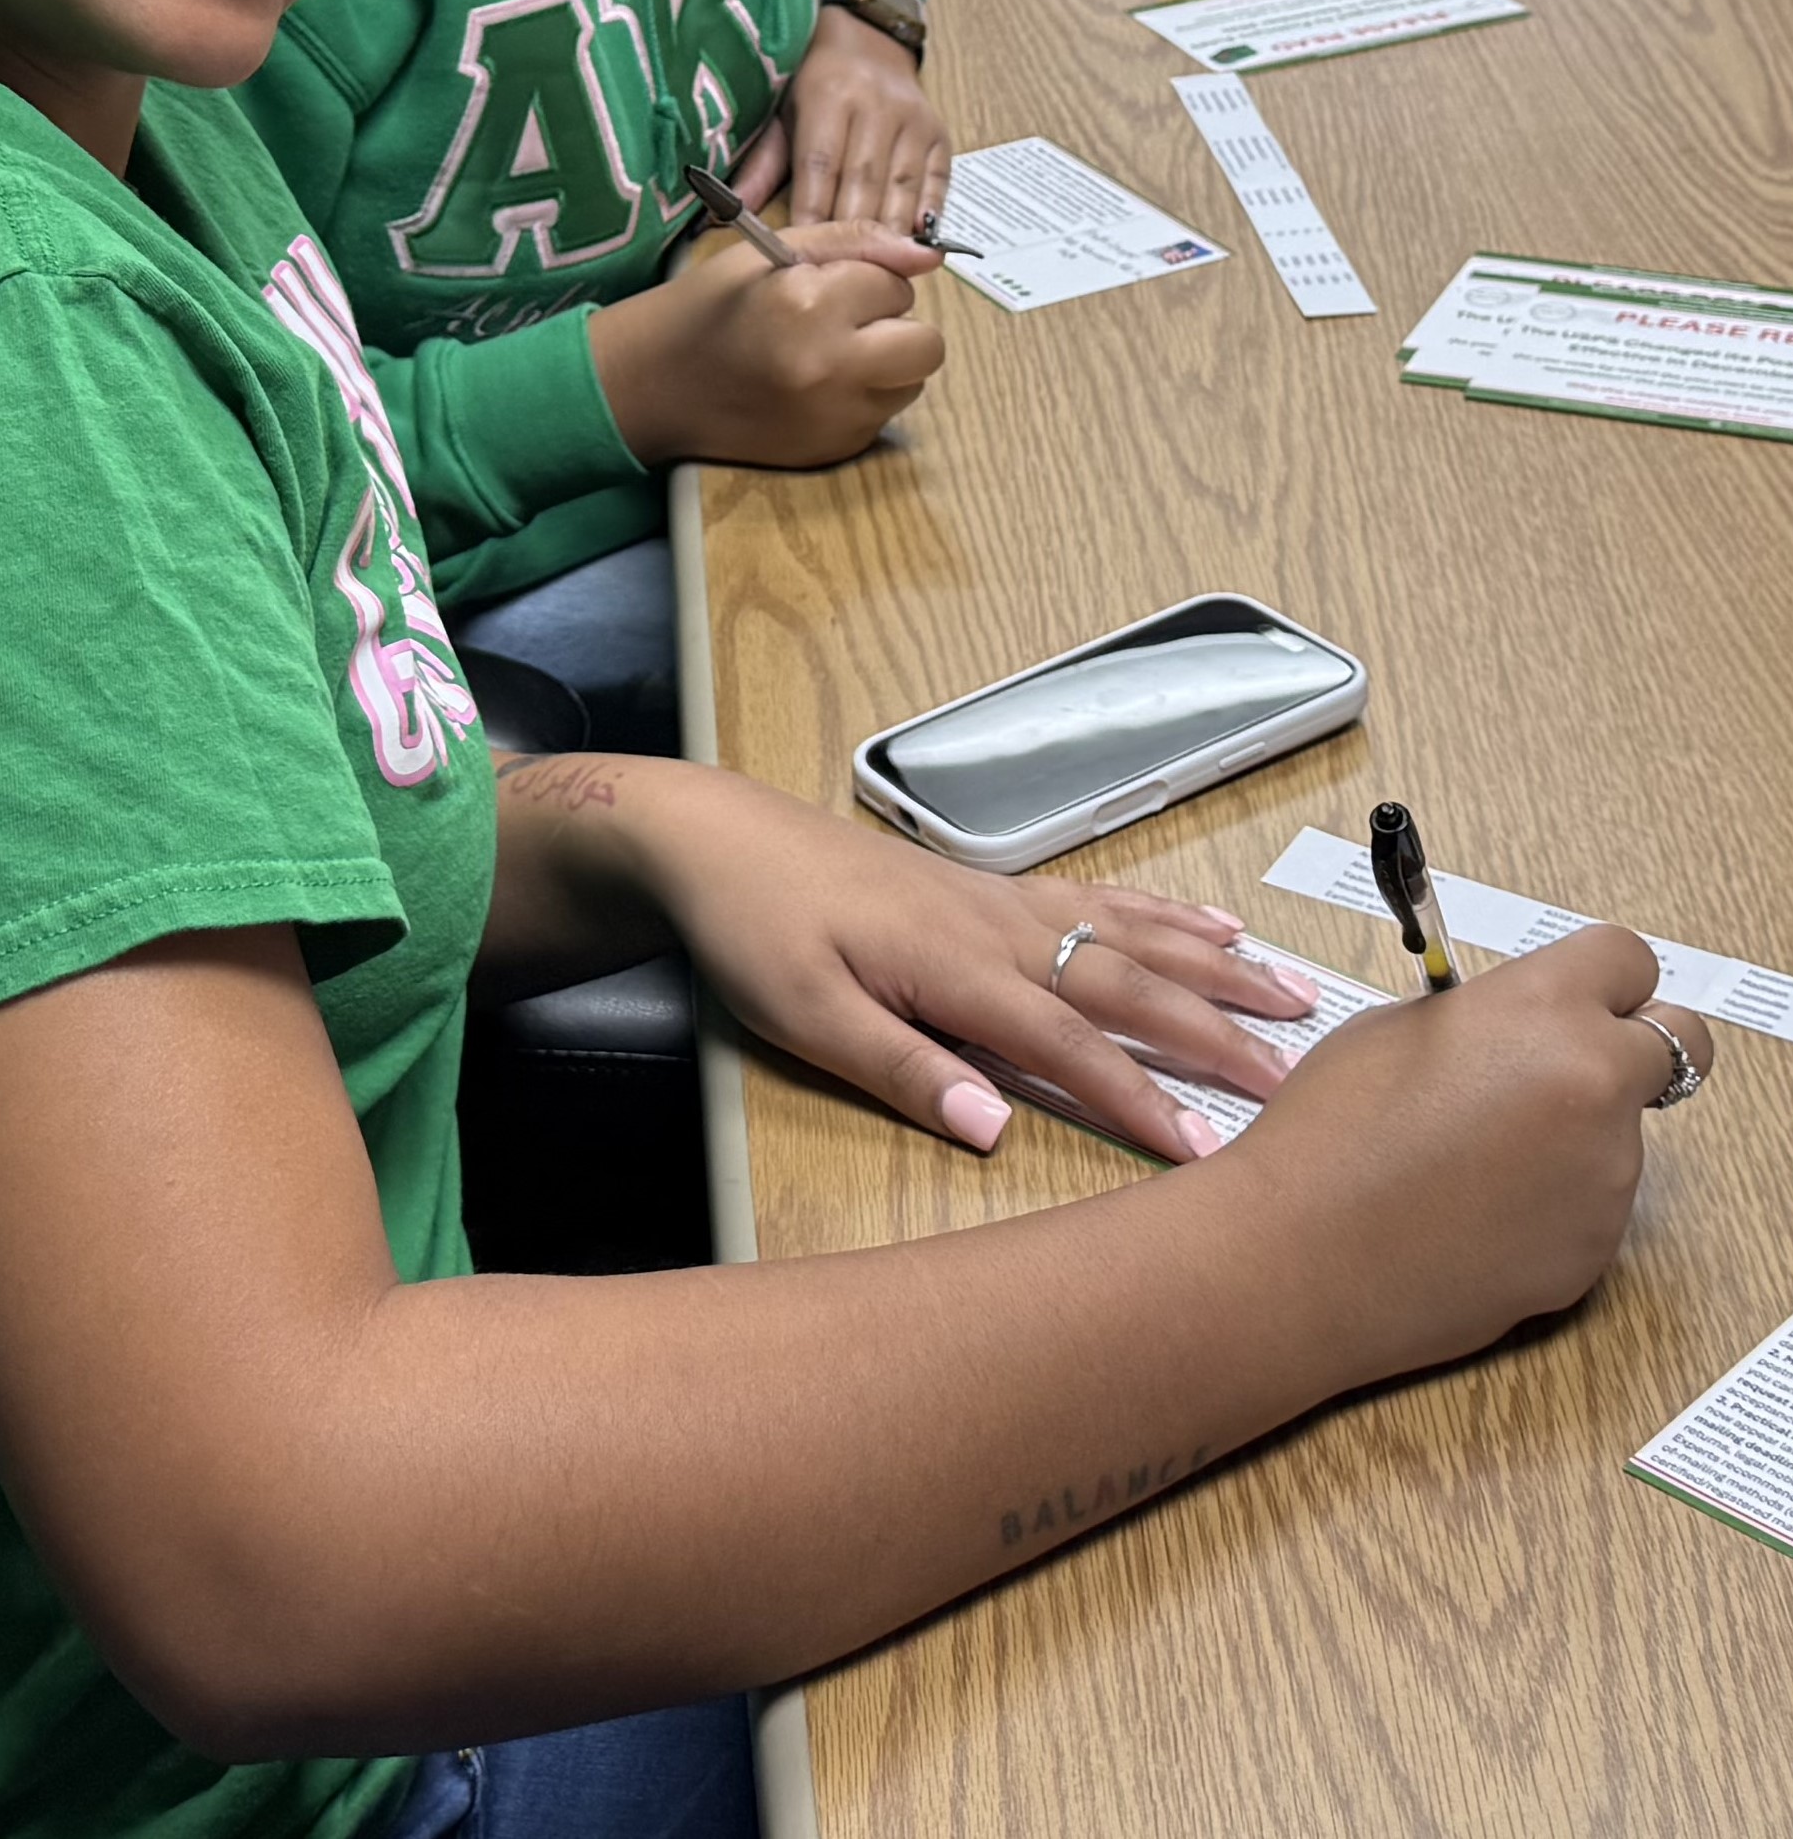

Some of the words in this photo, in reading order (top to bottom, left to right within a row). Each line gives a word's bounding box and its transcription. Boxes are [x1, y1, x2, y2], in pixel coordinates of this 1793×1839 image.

[1615, 310, 1750, 339] PLEASE
[1736, 1376, 1790, 1406] request
[1729, 1402, 1792, 1437] Practical
[1671, 1432, 1720, 1462] Experts
